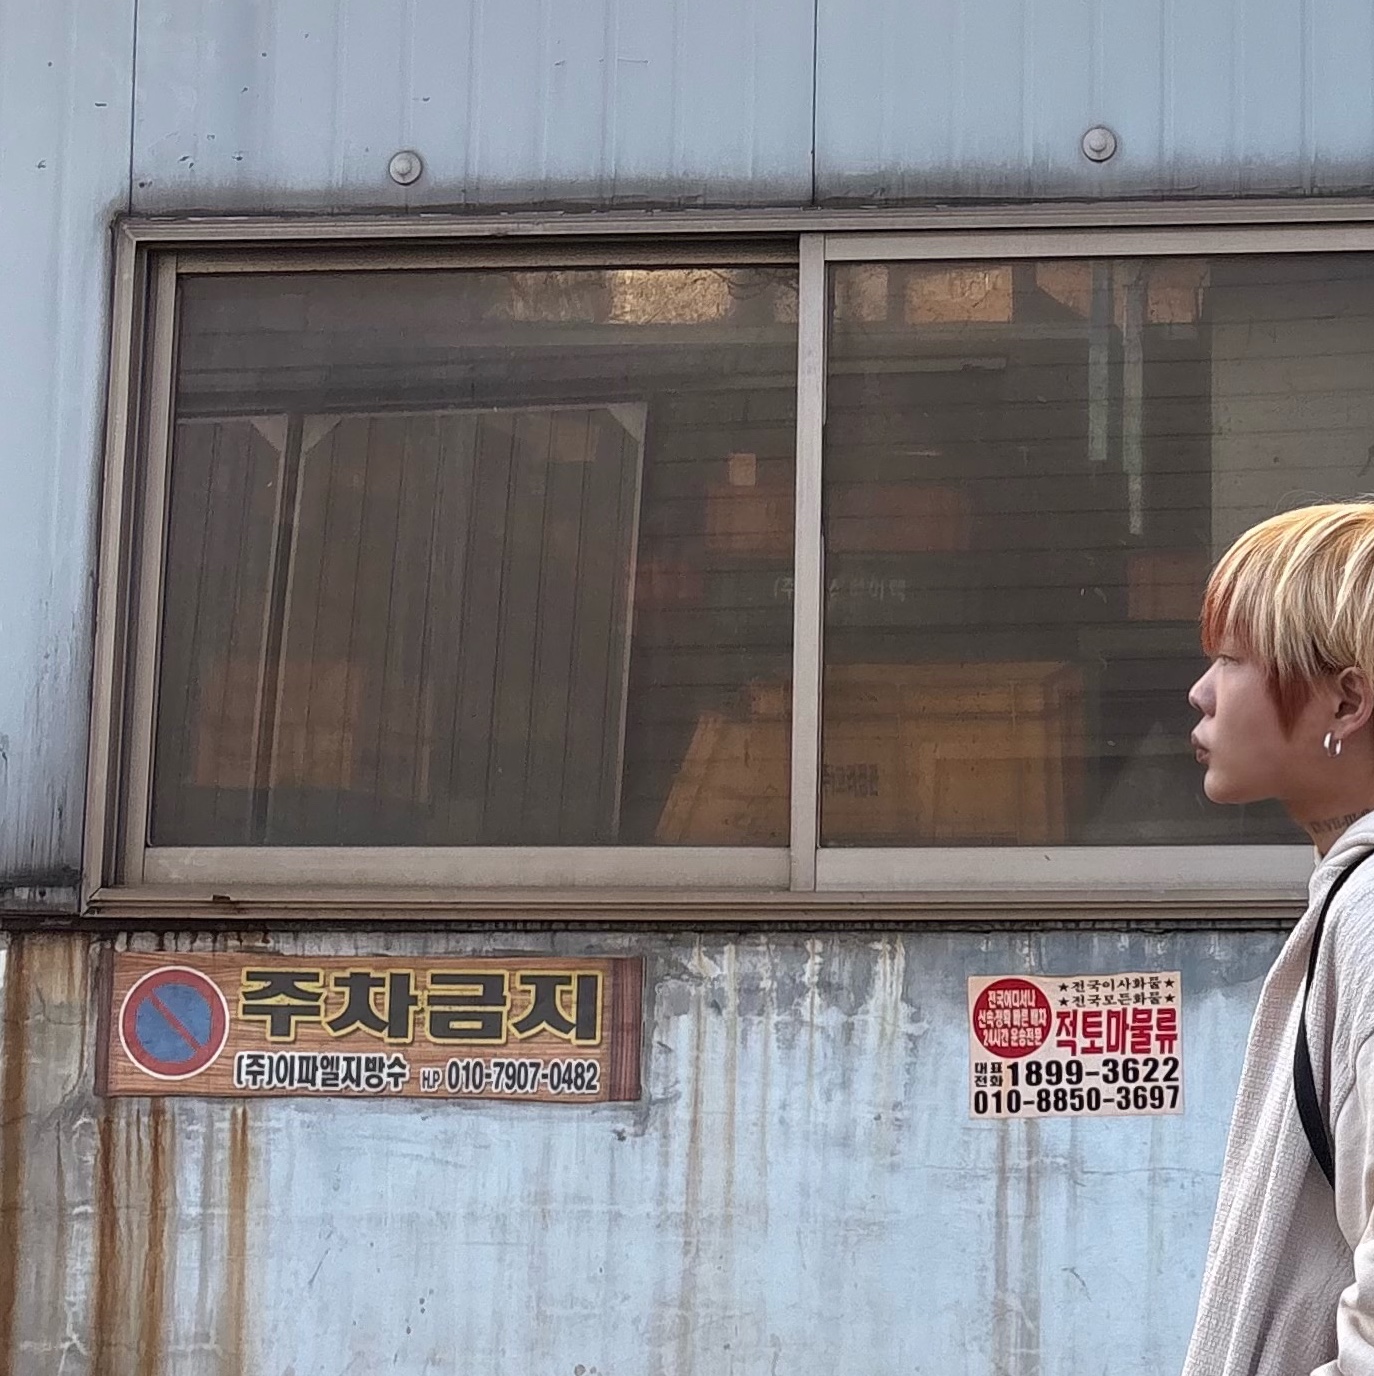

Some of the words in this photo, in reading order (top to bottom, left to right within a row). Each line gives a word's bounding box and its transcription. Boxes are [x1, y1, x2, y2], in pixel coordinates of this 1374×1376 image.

[1071, 977, 1162, 993] 전국이사화물
[239, 968, 602, 1044] 주차금지
[1072, 992, 1162, 1008] 전국모든화물
[1055, 1007, 1179, 1057] 적토마물류
[235, 1053, 408, 1091] (주)이파엘지방수
[446, 1060, 599, 1093] 010-7907-0482
[974, 1061, 1003, 1074] 대표
[974, 1075, 1003, 1087] 전화
[1006, 1057, 1179, 1087] 1899-3622
[973, 1086, 1180, 1114] 010-8850-3697
